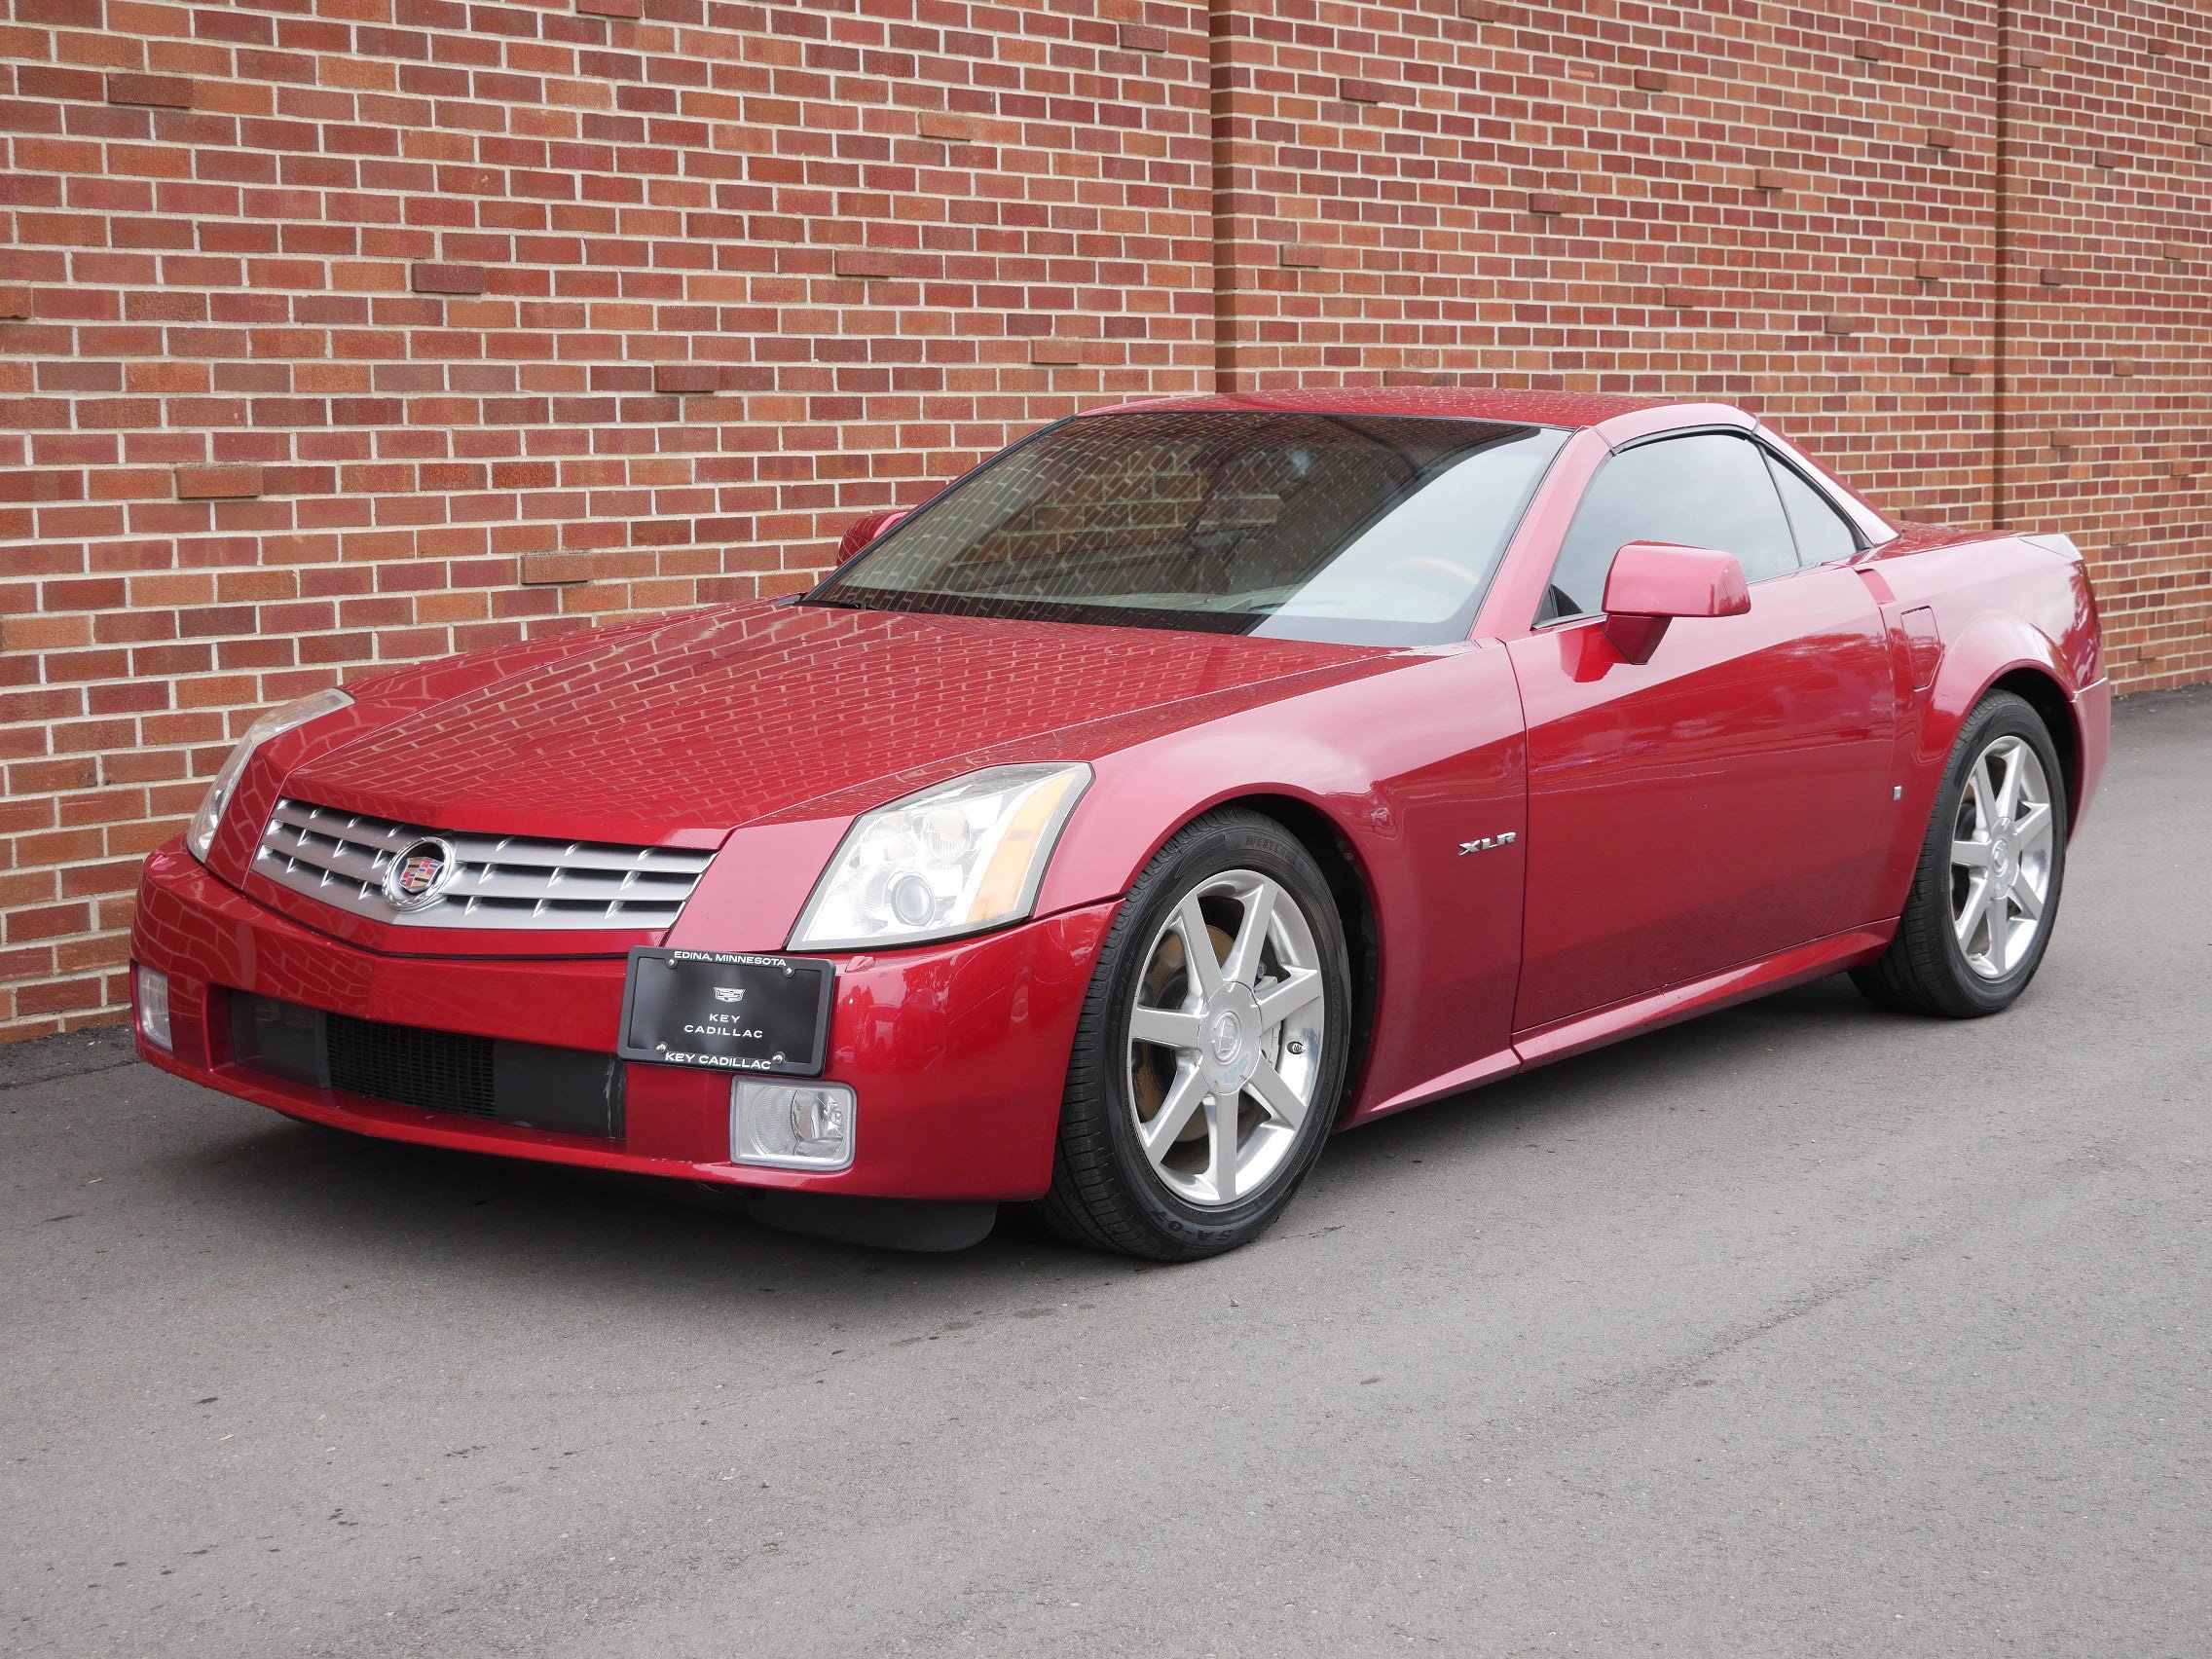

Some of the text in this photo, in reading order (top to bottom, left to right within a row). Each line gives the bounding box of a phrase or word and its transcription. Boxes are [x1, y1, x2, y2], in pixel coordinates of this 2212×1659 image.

[1457, 831, 1516, 857] XLR
[674, 950, 787, 967] EDINA, MINNESOTA
[709, 1014, 741, 1023] KEY
[683, 1025, 763, 1038] CADILLAC
[665, 1052, 771, 1069] KEY CADILLAC
